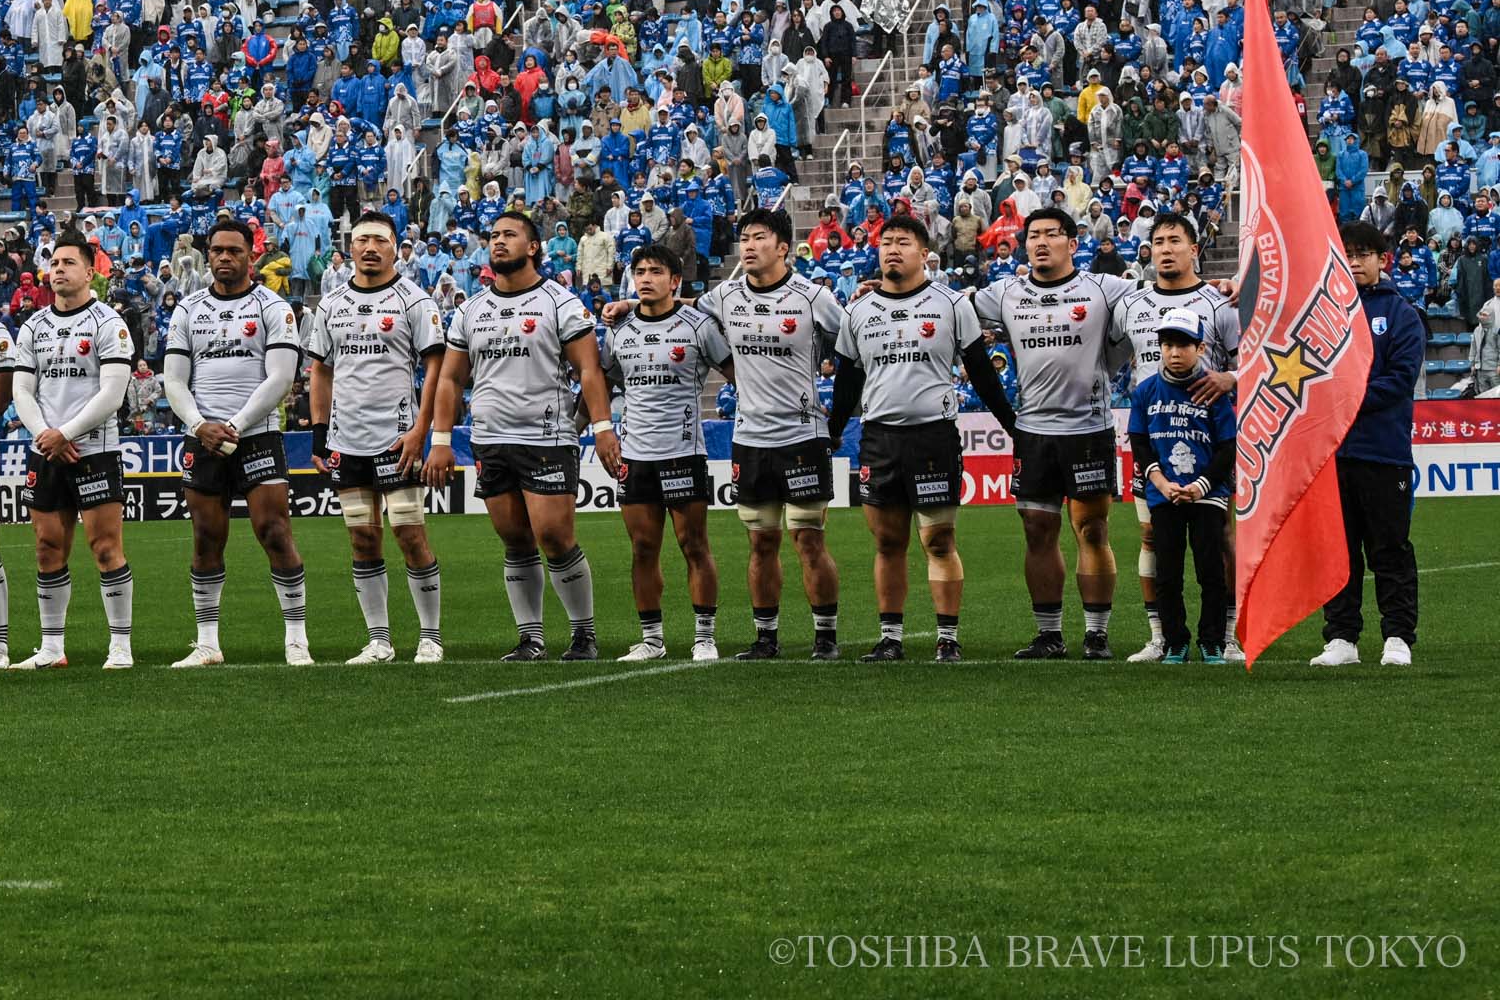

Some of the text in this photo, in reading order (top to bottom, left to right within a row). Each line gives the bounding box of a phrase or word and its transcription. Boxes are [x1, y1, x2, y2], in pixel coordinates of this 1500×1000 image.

[1020, 335, 1082, 349] TOSHIBA
[340, 344, 390, 355] TOSHIBA
[479, 347, 530, 360] TOSHIBA
[735, 345, 792, 357] TOSHIBA
[873, 351, 931, 367] TOSHIBA
[627, 375, 681, 386] TOSHIBA
[1169, 416, 1189, 427] KIDS
[1428, 462, 1500, 492] NTT
